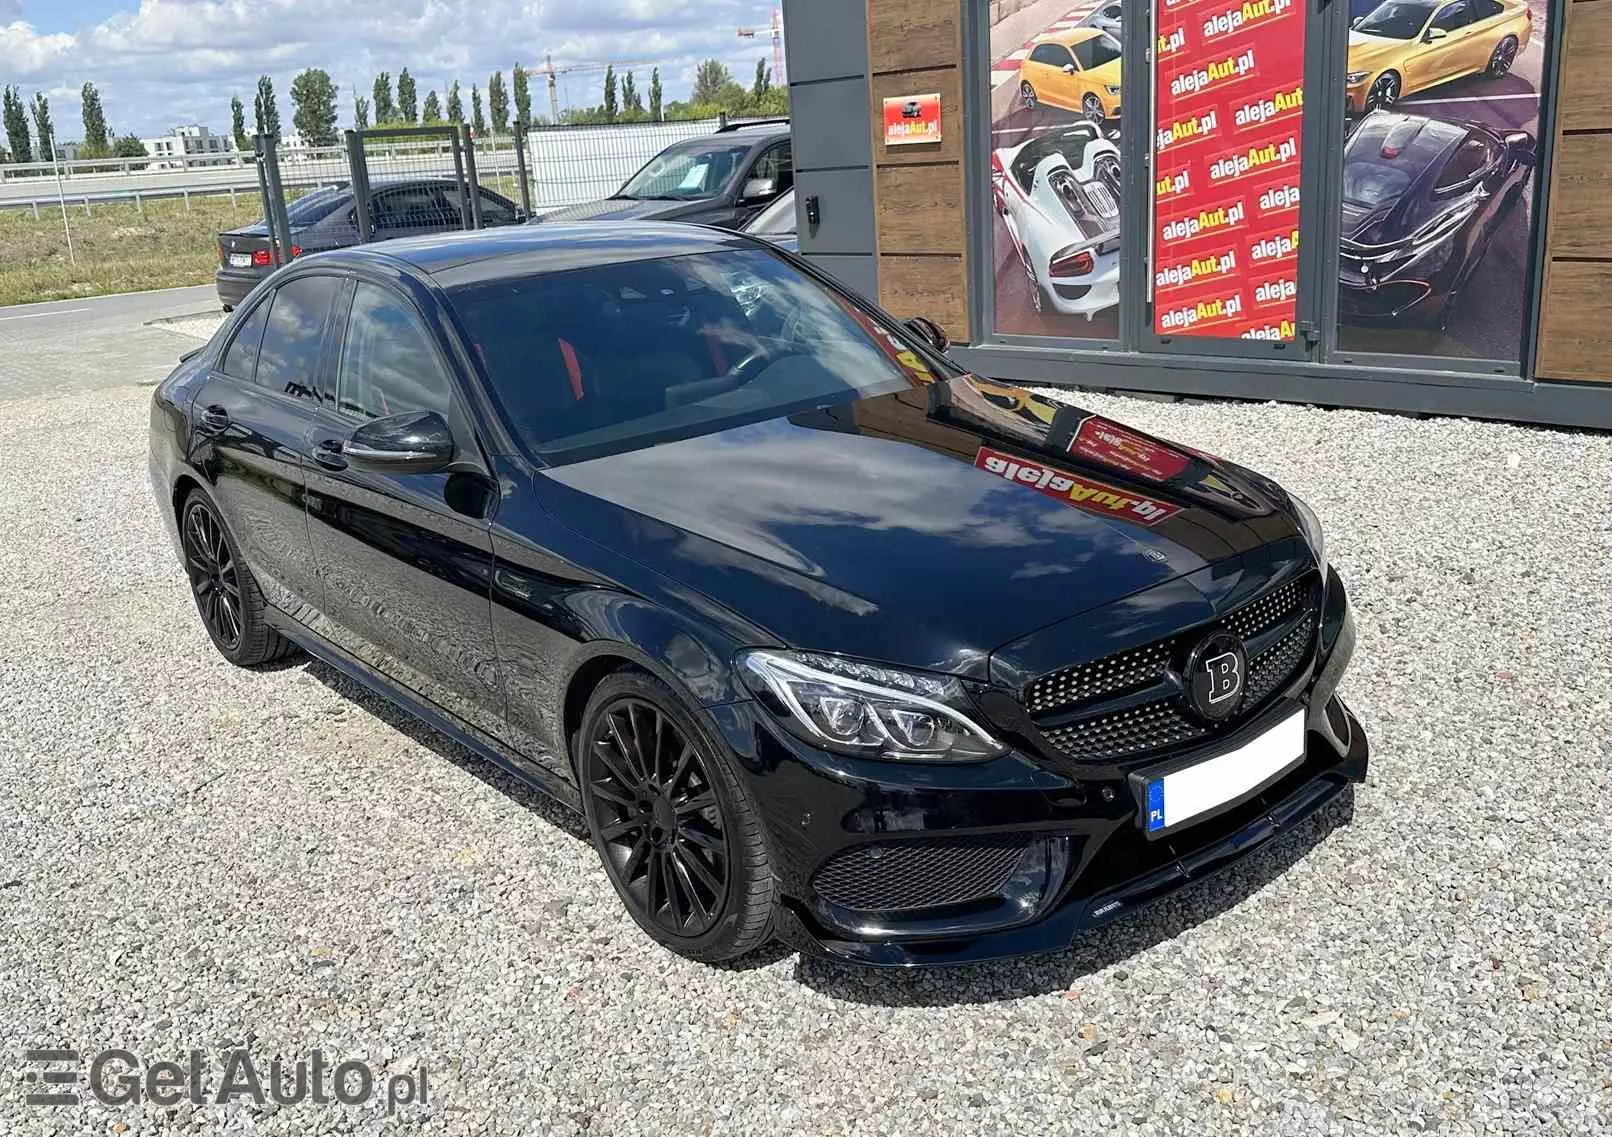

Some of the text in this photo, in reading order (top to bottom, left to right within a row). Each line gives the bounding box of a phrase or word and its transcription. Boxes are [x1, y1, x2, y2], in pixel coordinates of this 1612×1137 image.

[1171, 50, 1255, 95] alejaAut.pl
[1210, 137, 1297, 179] alejaAut.pl
[1260, 185, 1300, 210] aleja
[1163, 202, 1245, 240] alejaAut.pl
[1156, 250, 1236, 286] alejaAut.pl
[1161, 294, 1242, 328] alejaAut.pl
[1205, 652, 1241, 704] B
[1151, 808, 1163, 822] PL
